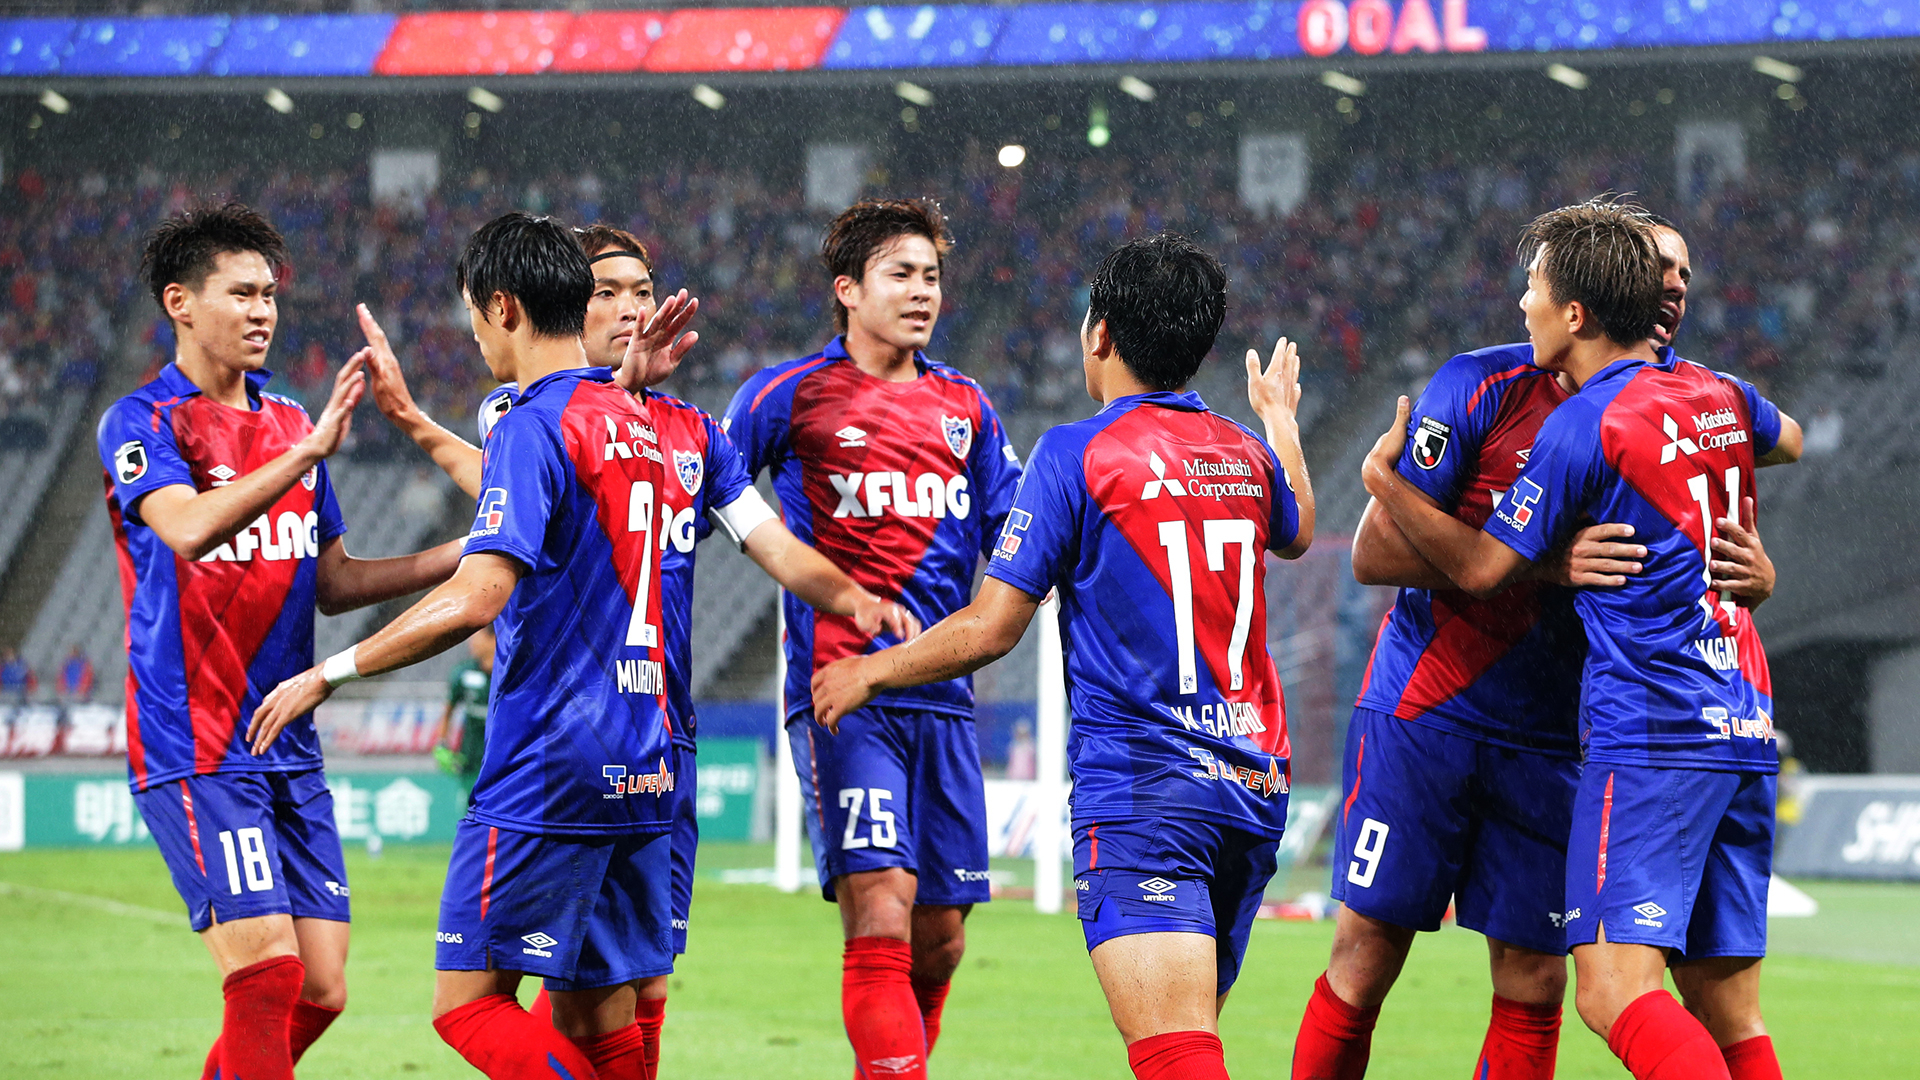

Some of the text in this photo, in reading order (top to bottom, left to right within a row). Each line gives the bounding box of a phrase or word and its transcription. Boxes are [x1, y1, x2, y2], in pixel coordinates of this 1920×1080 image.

[1182, 458, 1252, 477] Mitsubishi
[1187, 479, 1263, 502] Corporation
[828, 471, 971, 520] XFLAG
[625, 480, 658, 648] 2
[1157, 518, 1256, 695] 17
[839, 787, 898, 850] 25
[218, 827, 275, 895] 18
[1347, 817, 1390, 888] 9
[1142, 892, 1176, 902] umbro
[1634, 917, 1663, 928] umbro
[522, 947, 553, 959] umbro
